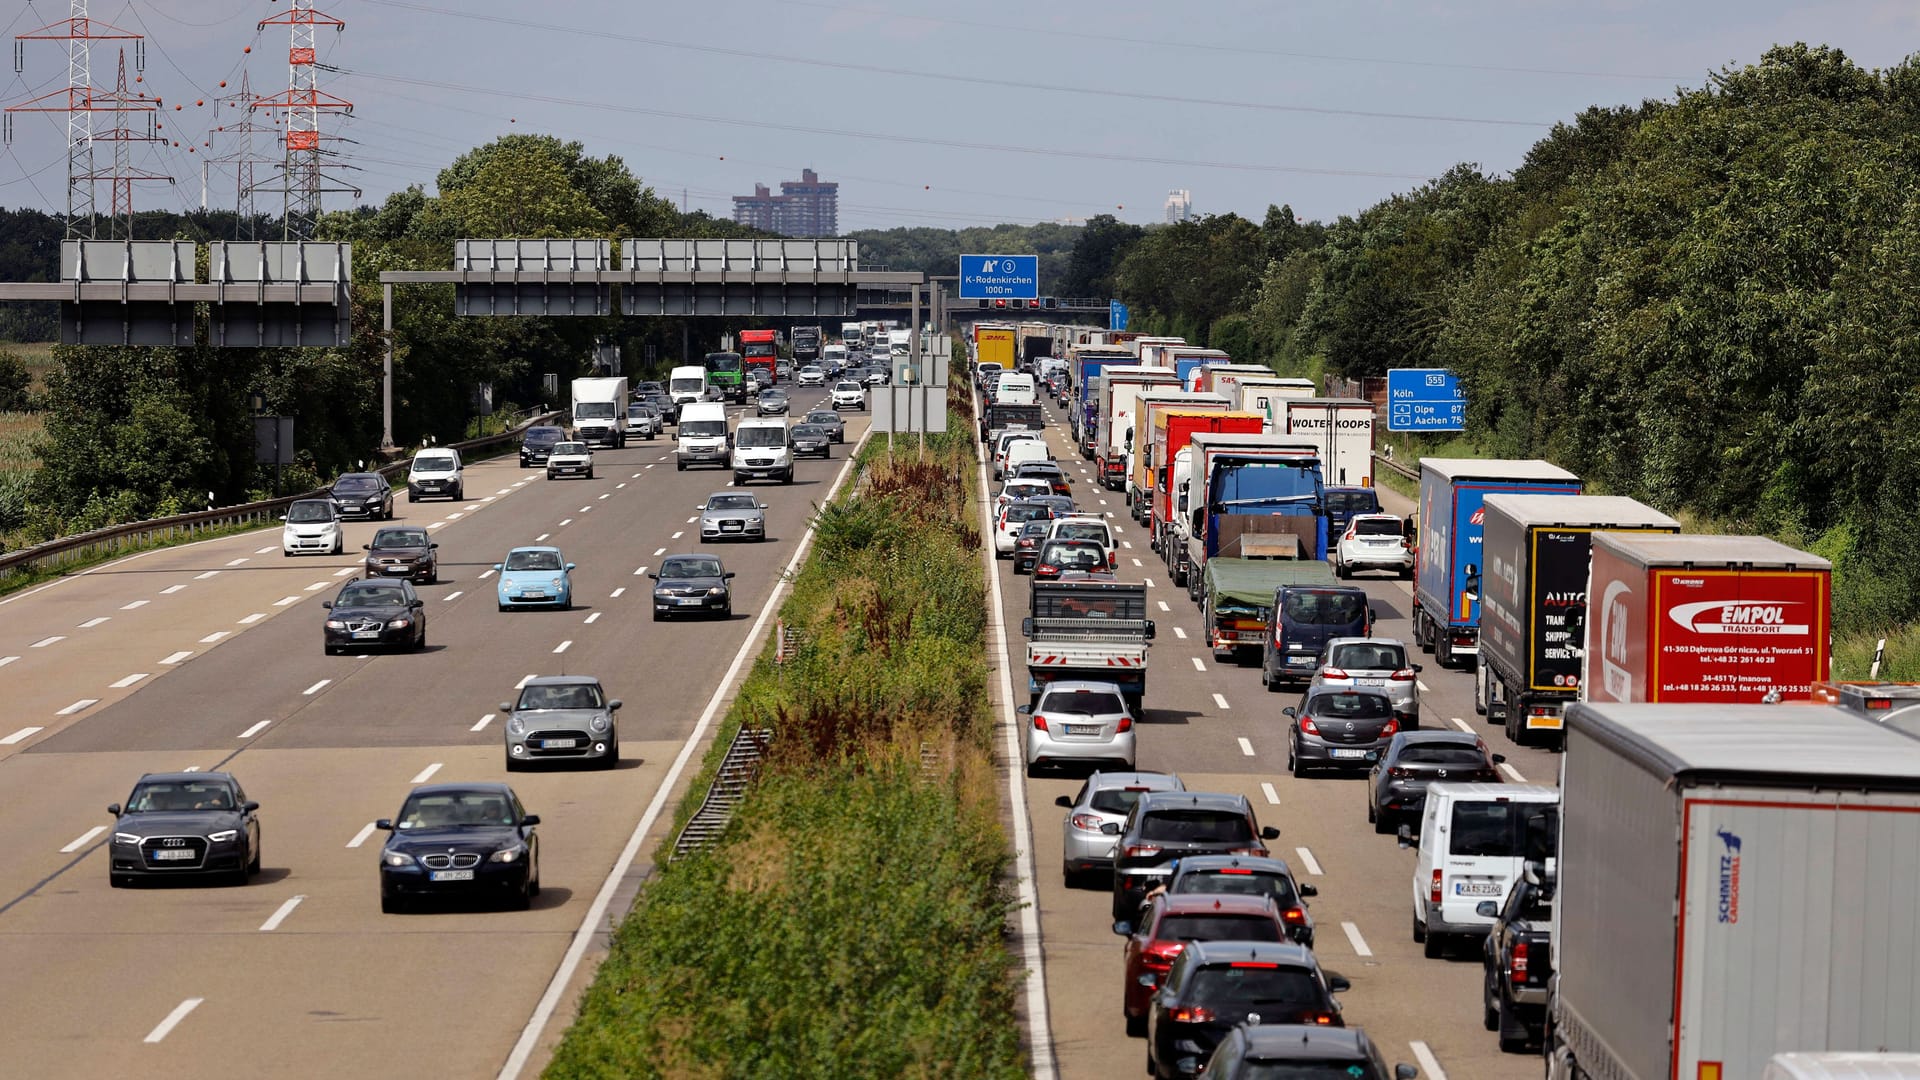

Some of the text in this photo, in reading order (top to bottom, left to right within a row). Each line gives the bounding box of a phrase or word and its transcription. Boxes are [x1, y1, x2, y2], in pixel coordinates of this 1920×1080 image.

[1006, 262, 1012, 270] 3
[966, 276, 1032, 284] K-Rodenkirchen
[1428, 376, 1442, 384] 555
[1393, 389, 1414, 398] Köln
[1414, 406, 1434, 415] Olpe
[1451, 406, 1462, 414] 87
[1292, 419, 1370, 428] WOLTER KOOPS
[1414, 416, 1448, 424] Aachen
[1451, 416, 1462, 424] 75
[1721, 606, 1784, 624] EMPOL
[1544, 648, 1570, 658] SERVICE
[1690, 645, 1723, 654] Dąbrowa
[1718, 856, 1731, 923] SCHMITZ
[1730, 856, 1740, 924] CARGOBULL
